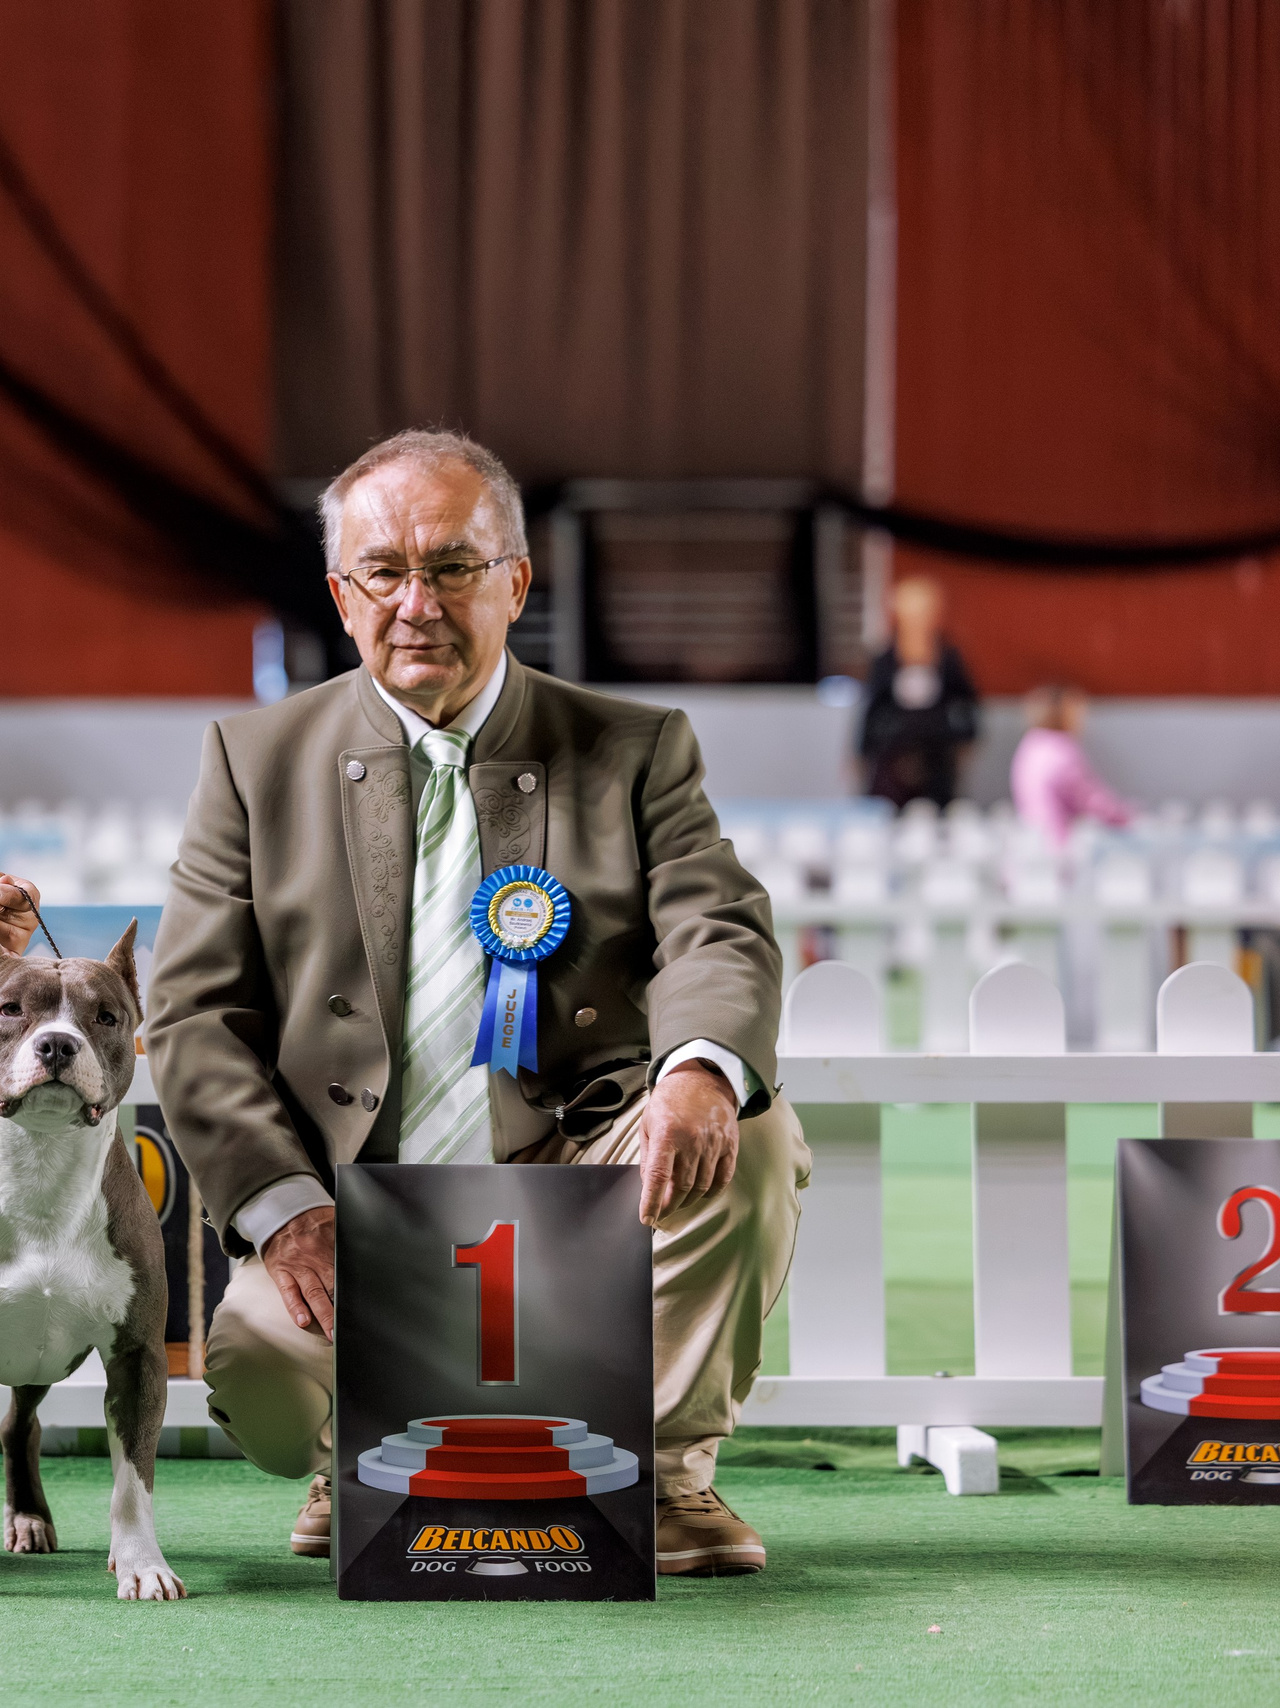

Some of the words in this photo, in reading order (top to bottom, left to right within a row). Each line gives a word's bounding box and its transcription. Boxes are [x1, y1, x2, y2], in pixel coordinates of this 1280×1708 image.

[502, 989, 517, 1048] JUDGE
[1217, 1185, 1280, 1316] 2
[451, 1219, 520, 1387] 1
[1187, 1440, 1280, 1465] BELCA
[1190, 1470, 1233, 1481] DOG
[408, 1525, 584, 1553] BELCANDO
[410, 1561, 457, 1573] DOG
[534, 1561, 592, 1573] FOOD
